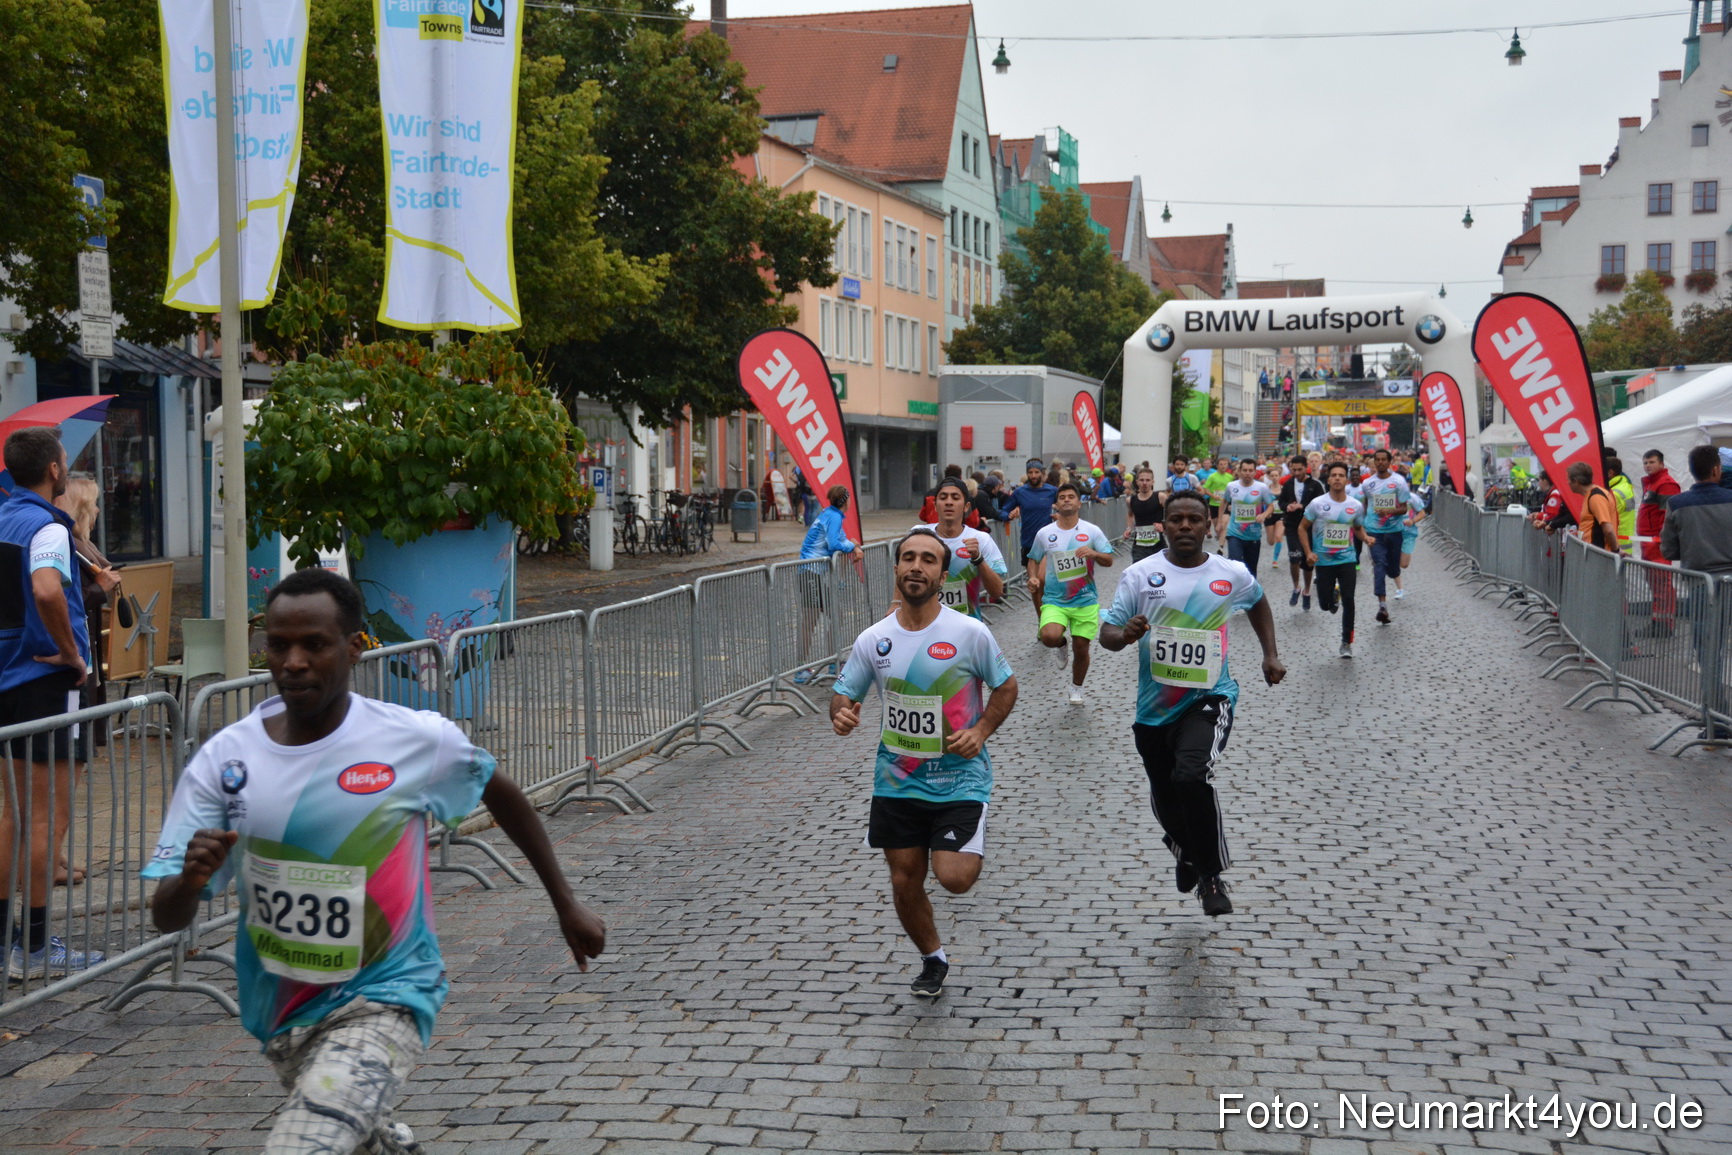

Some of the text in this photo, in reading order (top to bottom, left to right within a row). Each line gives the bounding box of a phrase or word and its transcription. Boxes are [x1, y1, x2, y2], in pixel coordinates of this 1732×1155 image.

[421, 20, 462, 34] Towns
[472, 25, 503, 35] FAIRTRADE
[388, 113, 432, 137] Wir
[395, 185, 463, 209] Stadt
[1185, 305, 1404, 333] BMW Laufsport
[1344, 402, 1371, 412] ZIEL
[595, 472, 603, 484] P
[1375, 498, 1394, 507] 5250
[1236, 508, 1255, 516] 5210
[1326, 529, 1348, 539] 5237
[1057, 557, 1084, 571] 5314
[938, 589, 962, 605] 201
[1156, 640, 1206, 666] 5199
[1167, 668, 1188, 679] Kedir
[903, 697, 936, 706] BOCK
[888, 705, 936, 735] 5203
[897, 737, 921, 750] Hasan
[926, 761, 943, 771] 17.
[345, 770, 390, 787] Hervis
[288, 866, 352, 885] BOCK
[253, 883, 350, 939] 5238
[257, 933, 344, 968] Moammad
